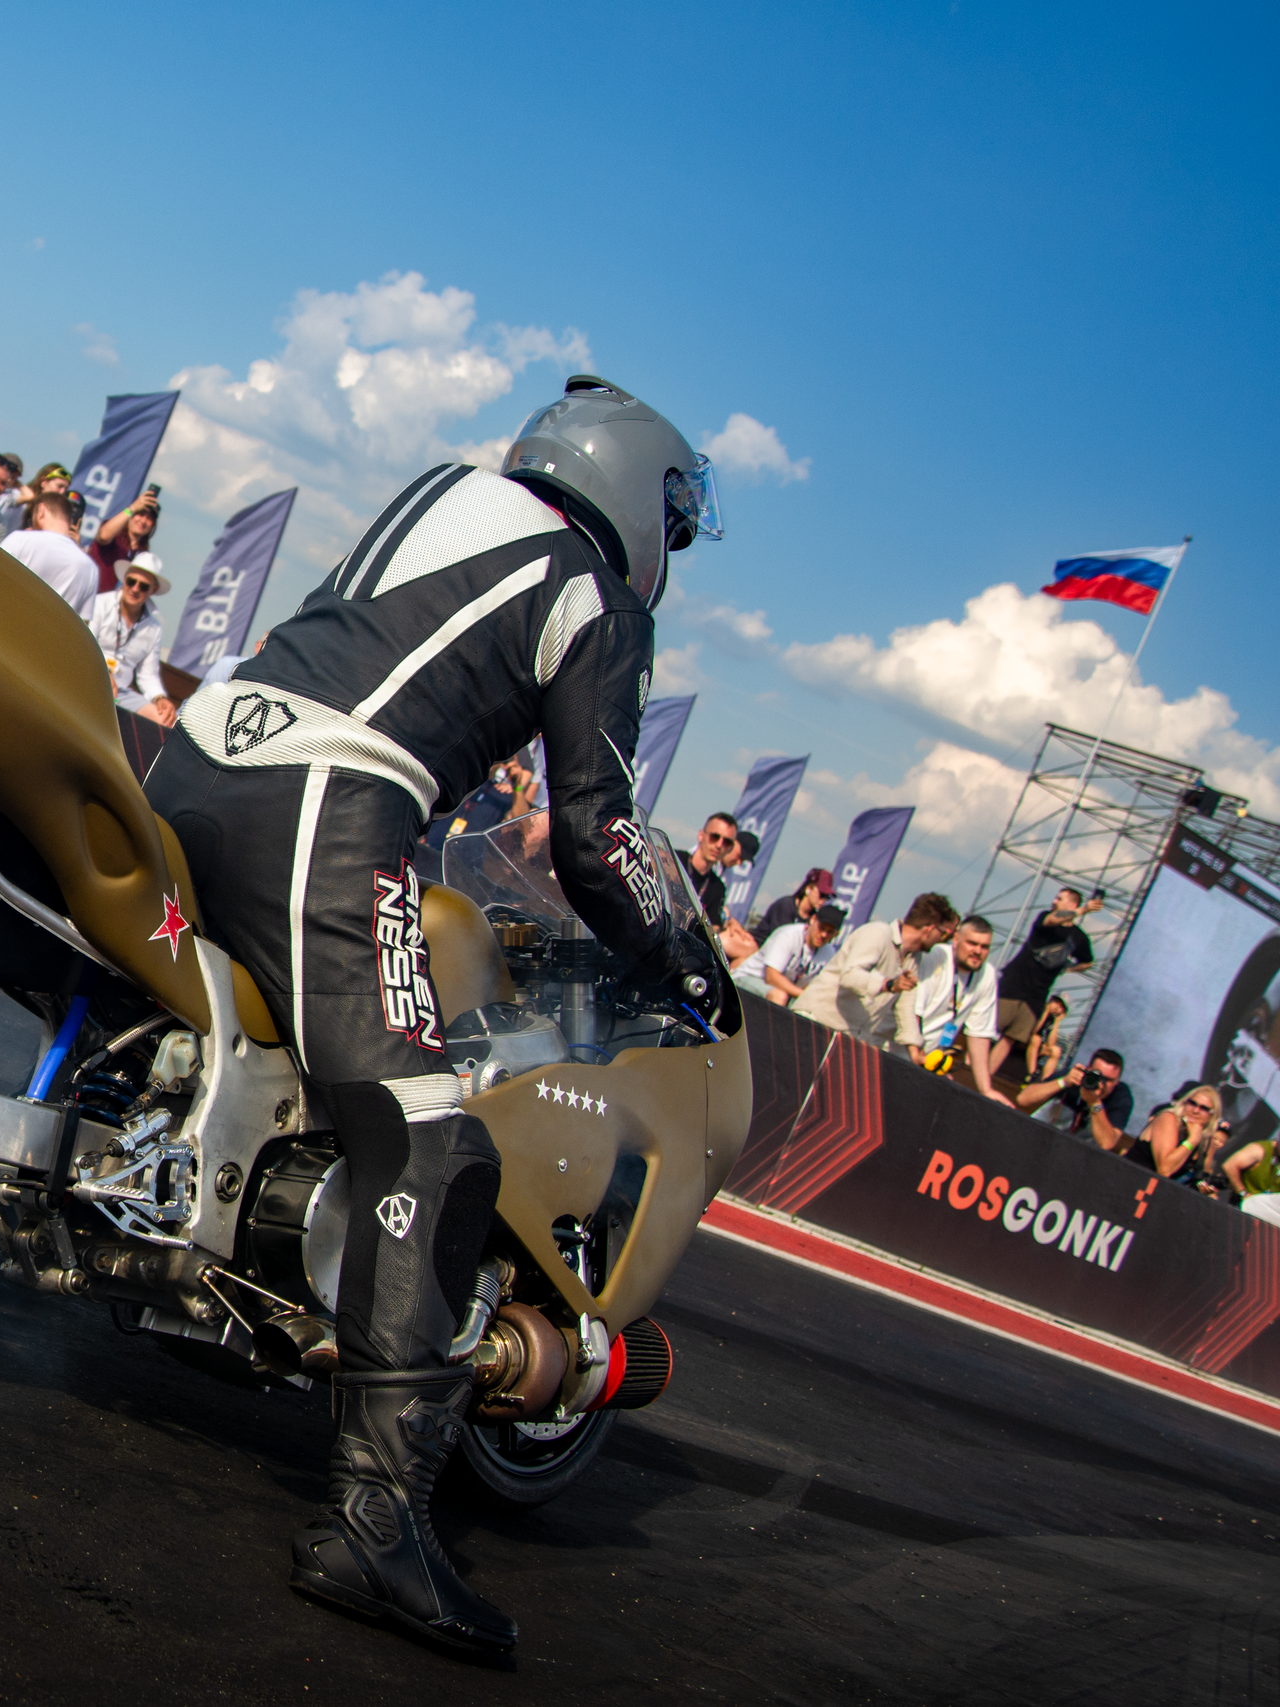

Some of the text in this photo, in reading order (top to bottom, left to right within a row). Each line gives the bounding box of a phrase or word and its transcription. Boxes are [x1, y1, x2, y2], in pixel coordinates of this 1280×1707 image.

[607, 845, 660, 927] NESS
[377, 877, 417, 1028] NESS
[917, 1149, 1135, 1272] ROSGONKI
